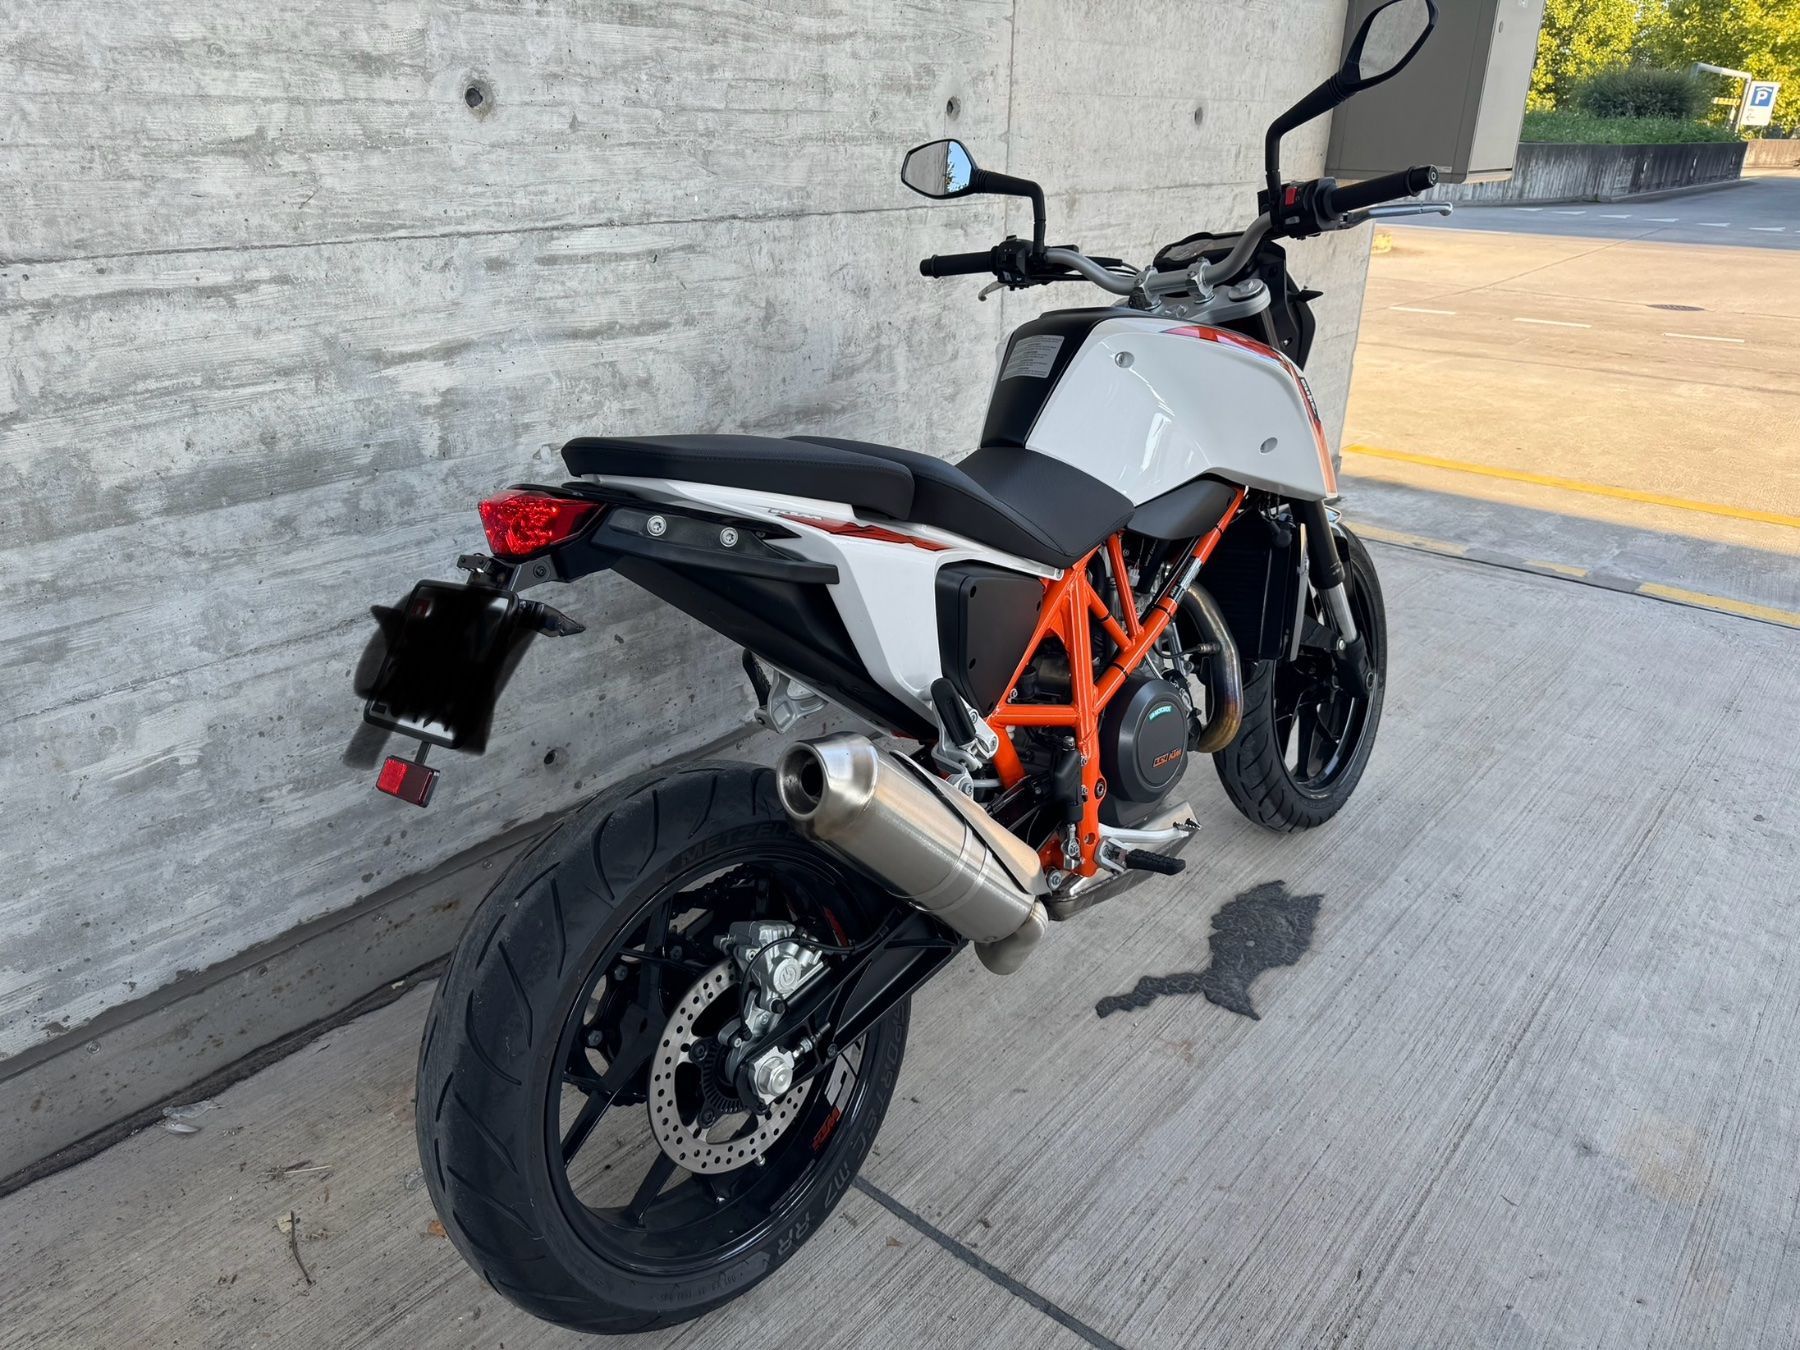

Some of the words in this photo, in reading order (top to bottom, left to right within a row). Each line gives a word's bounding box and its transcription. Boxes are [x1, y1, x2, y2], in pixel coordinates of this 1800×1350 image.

[1754, 90, 1769, 105] P
[851, 1002, 906, 1161] SPORTEC
[824, 1160, 851, 1209] M7
[778, 1210, 811, 1256] RR
